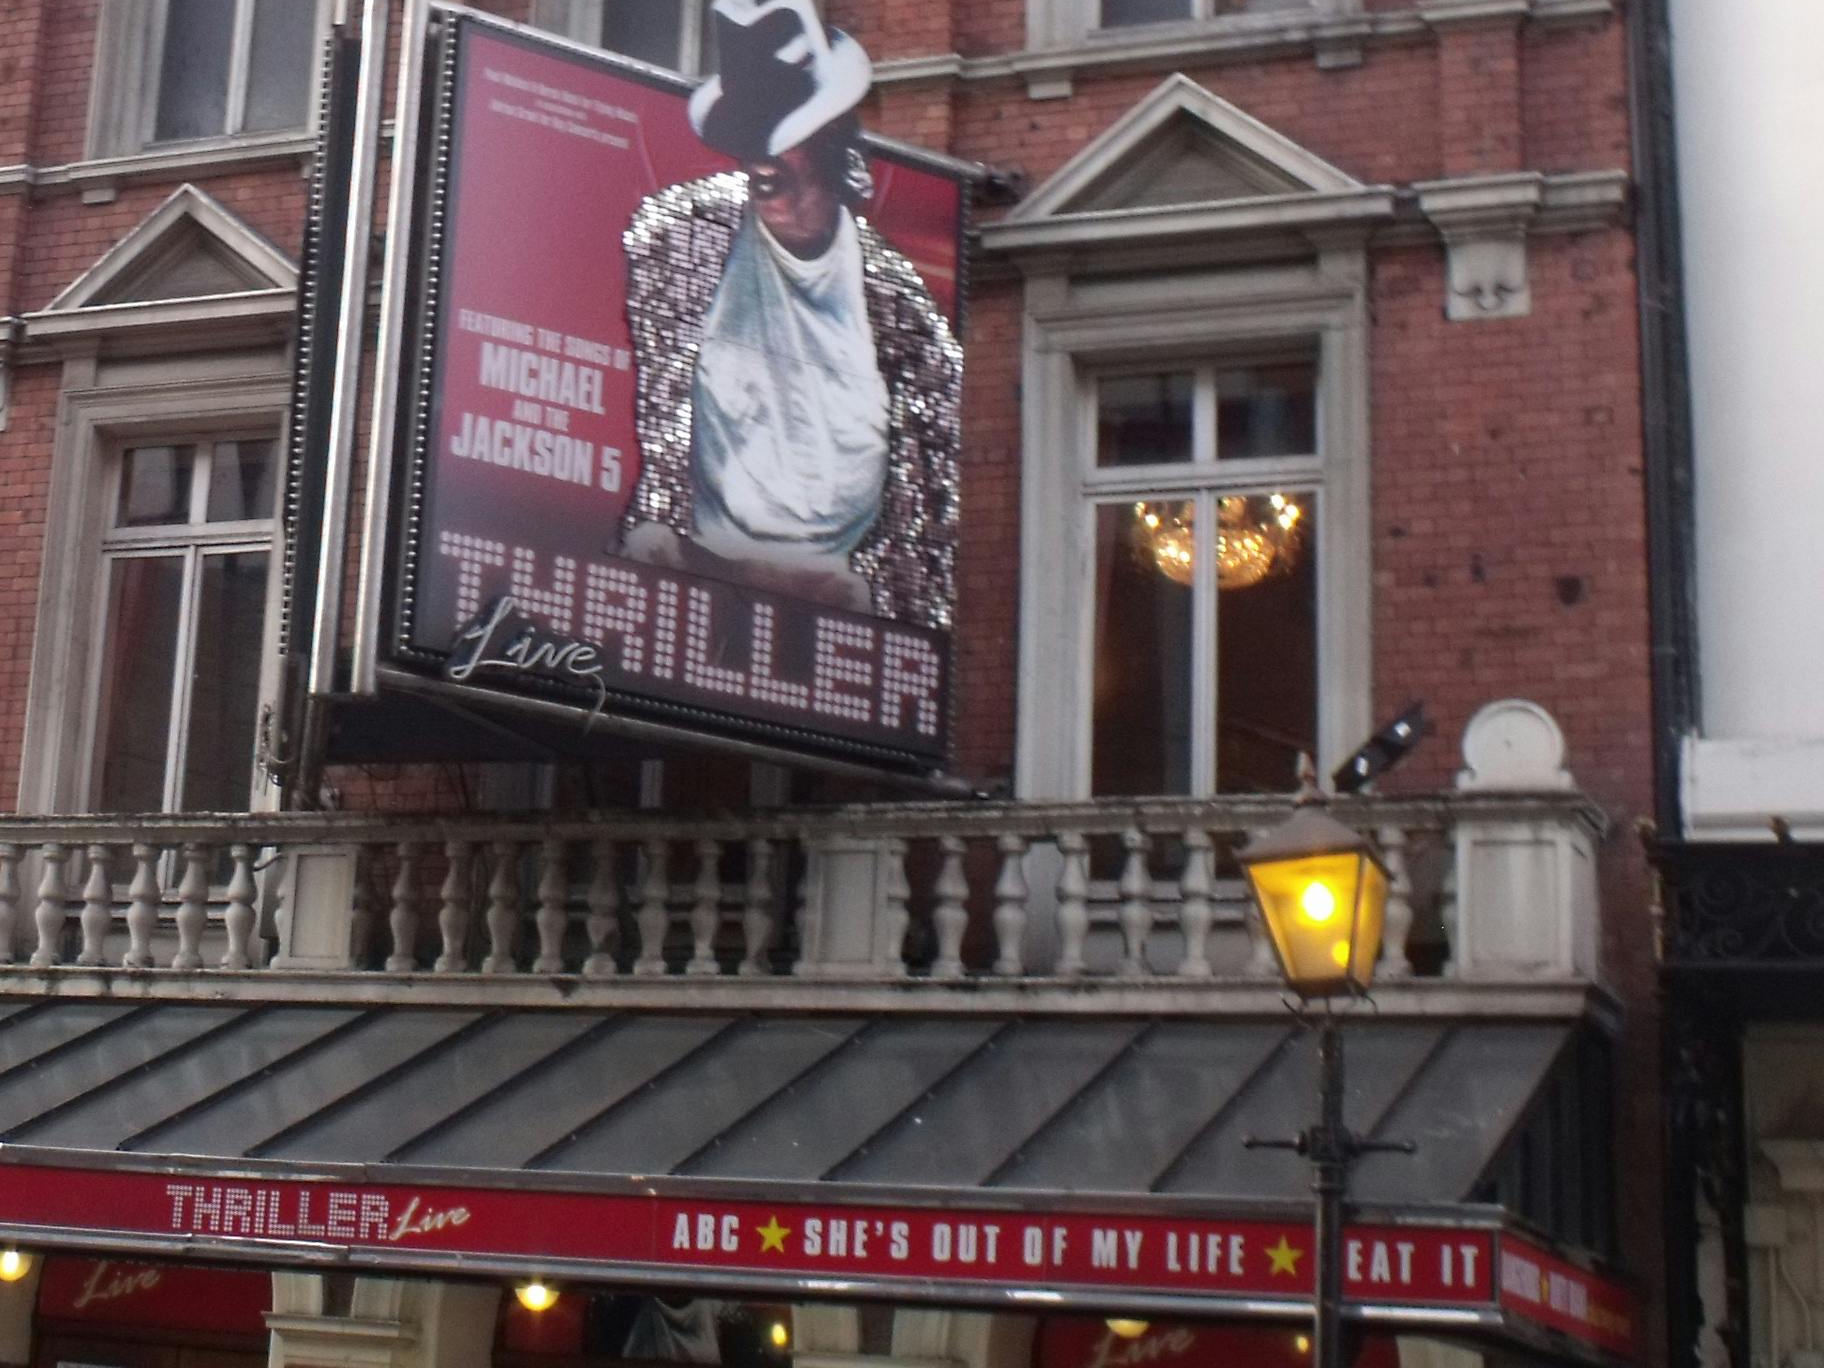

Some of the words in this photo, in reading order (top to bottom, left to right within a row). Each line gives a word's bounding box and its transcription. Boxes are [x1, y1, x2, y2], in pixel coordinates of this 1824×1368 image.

[480, 341, 605, 415] MICHAEL
[450, 412, 594, 487] JACKSON
[599, 446, 622, 492] 5
[440, 531, 938, 735] THRILLER
[449, 595, 604, 682] Live
[165, 1184, 390, 1240] THRILLER
[389, 1195, 470, 1241] Live
[672, 1212, 740, 1252] ABC
[804, 1217, 910, 1261] SHE'S
[932, 1223, 1000, 1264] OUT
[1023, 1227, 1068, 1267] OF
[1091, 1229, 1144, 1270] MY
[1167, 1232, 1245, 1275] LIFE
[1347, 1239, 1415, 1285] EAT
[1440, 1243, 1479, 1287] IT
[74, 1260, 161, 1308] Live
